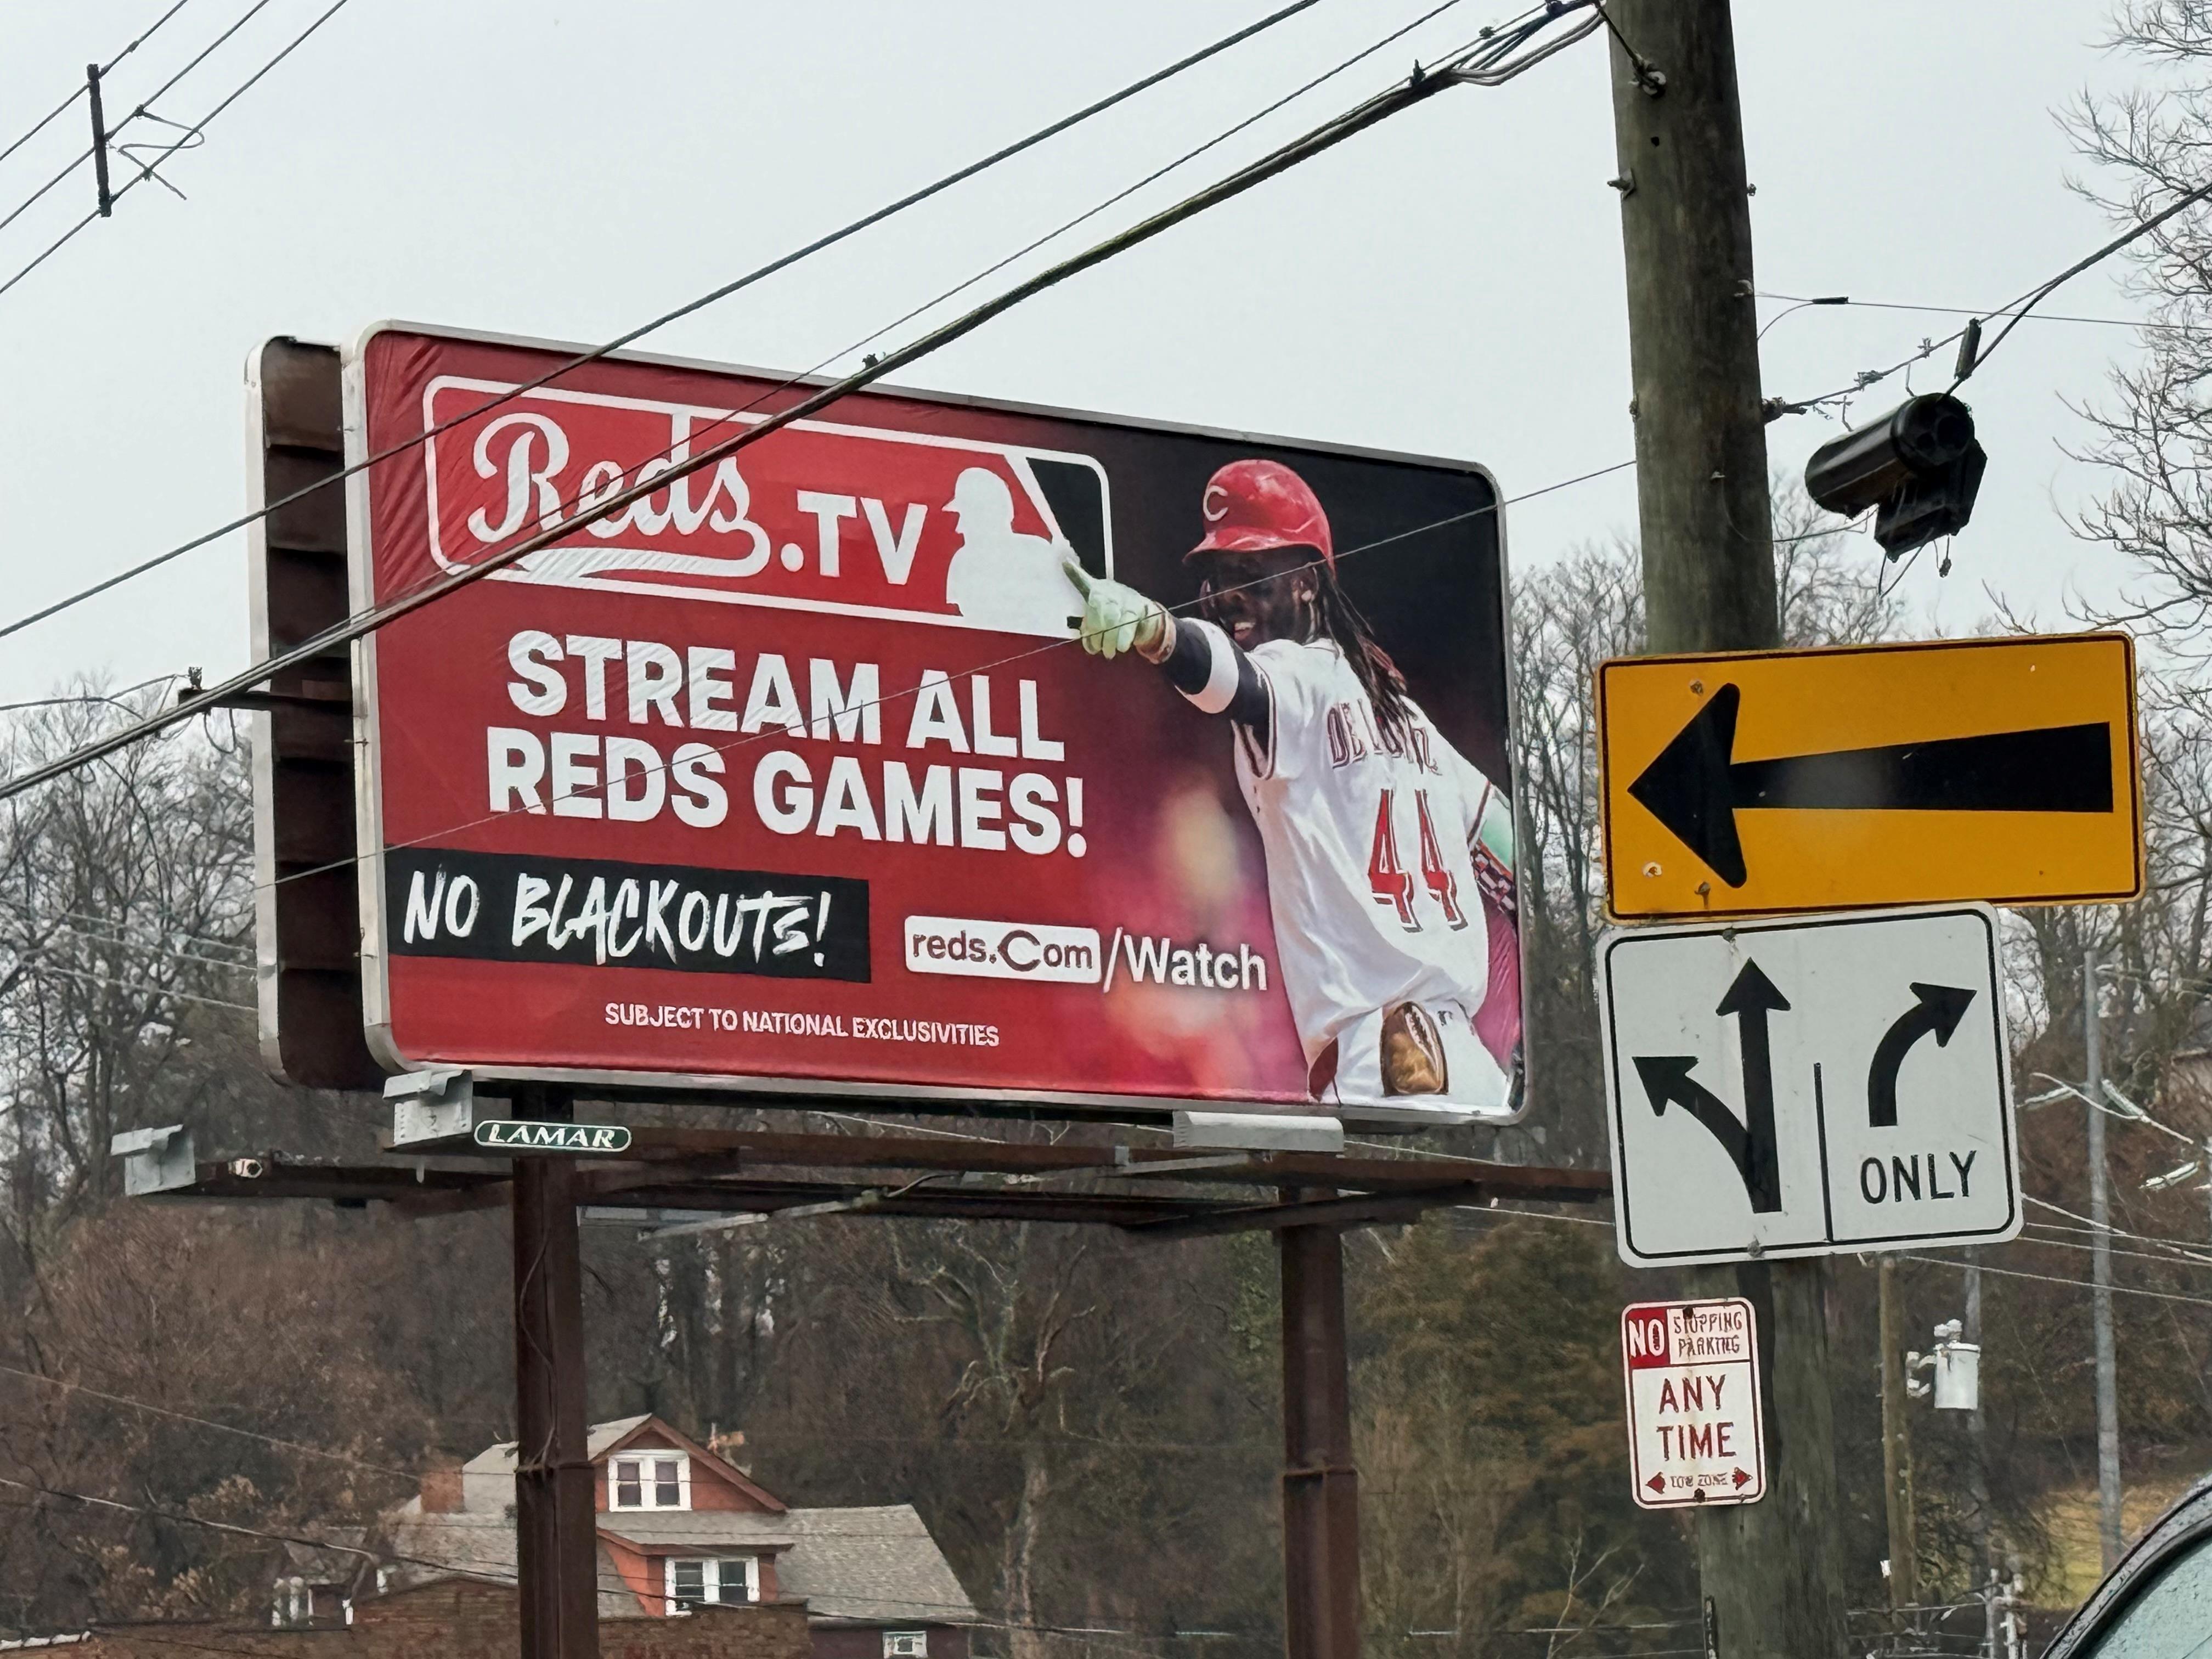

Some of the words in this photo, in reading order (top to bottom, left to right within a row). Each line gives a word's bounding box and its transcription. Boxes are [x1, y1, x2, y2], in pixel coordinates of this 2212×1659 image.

[1203, 485, 1228, 522] C
[507, 629, 882, 744] STREAM
[906, 669, 1065, 762] ALL
[487, 726, 729, 828] REDS
[753, 749, 1087, 858] GAMES!
[1367, 787, 1468, 932] 44
[404, 866, 480, 944] NO
[605, 1002, 704, 1029] SUBJECT
[709, 1008, 738, 1031] TO
[743, 1011, 848, 1038] NATIONAL
[853, 1017, 1000, 1047] EXCLUSIVITIES
[487, 1124, 615, 1149] LAMAR
[1859, 1150, 1977, 1205] ONLY
[1628, 1318, 1665, 1358] NO
[1673, 1311, 1743, 1334] STOPPING
[1658, 1374, 1726, 1415] ANY
[1656, 1421, 1737, 1462] TIME
